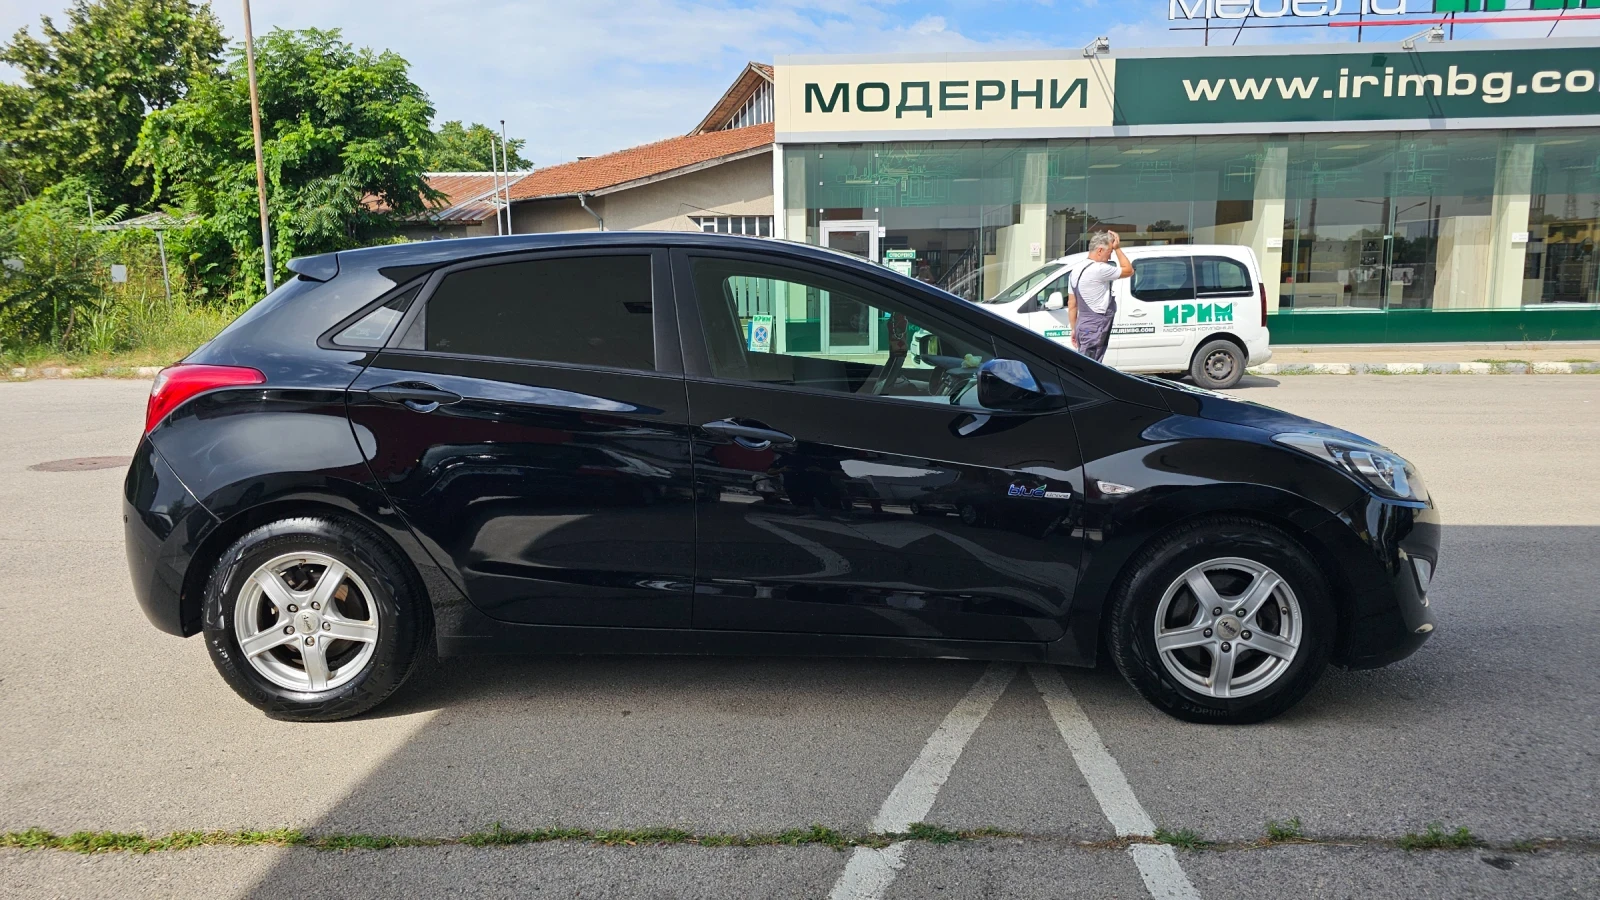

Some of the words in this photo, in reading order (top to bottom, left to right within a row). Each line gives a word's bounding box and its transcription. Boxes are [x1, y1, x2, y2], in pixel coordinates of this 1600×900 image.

[804, 77, 1089, 119] МОДЕРНИ
[1182, 65, 1600, 104] www.irimbg.co
[1163, 302, 1234, 325] ИРИМ
[1008, 484, 1047, 498] blue
